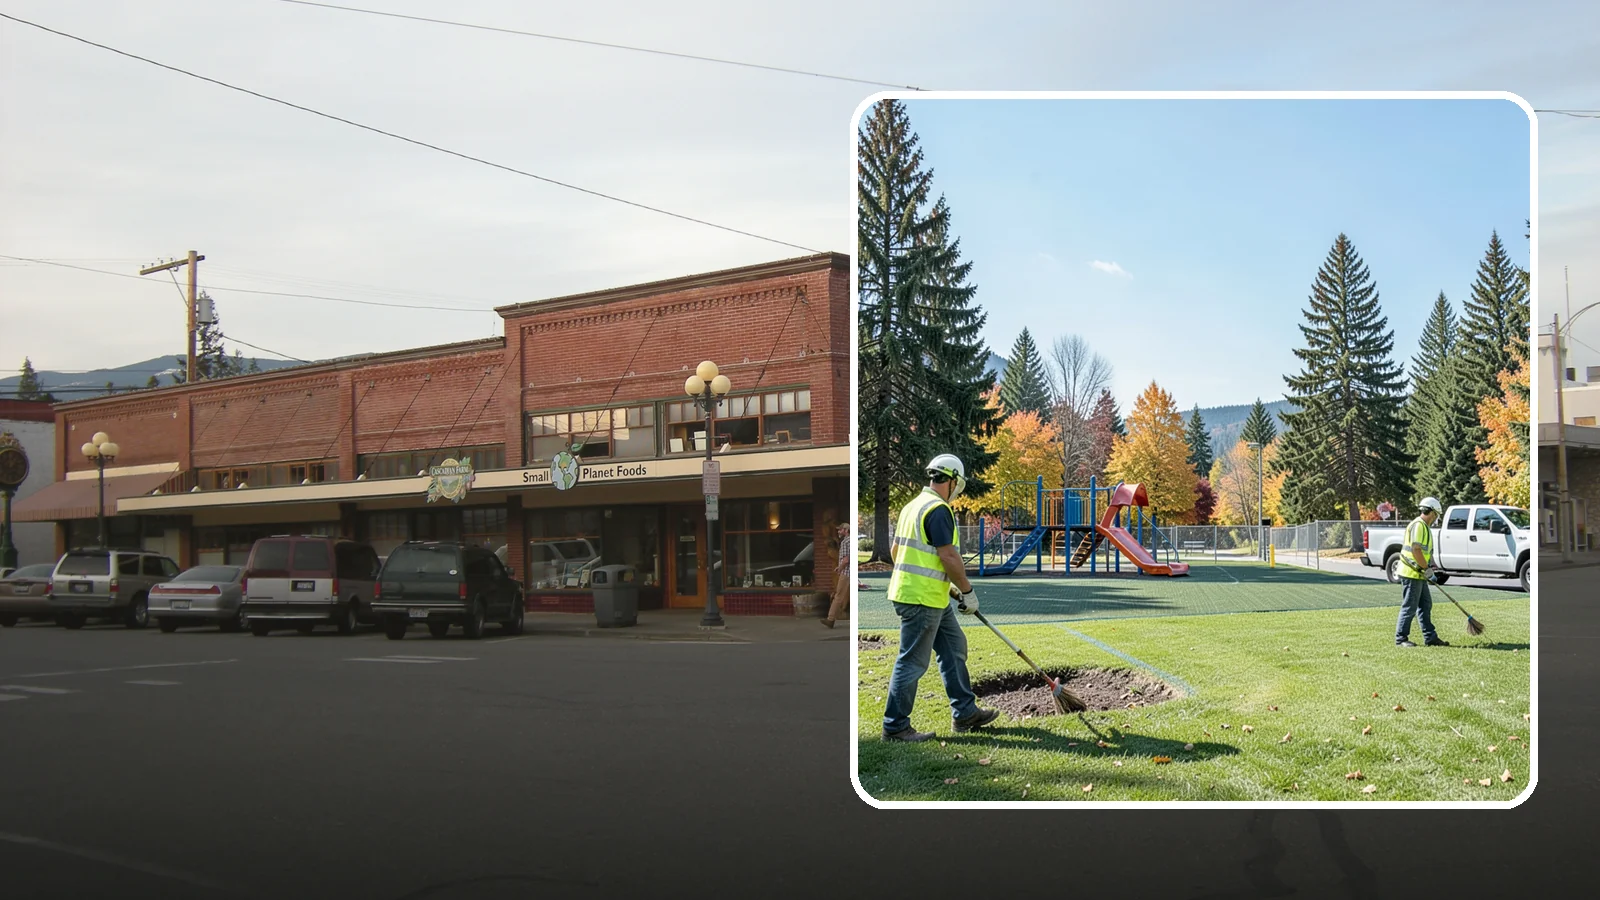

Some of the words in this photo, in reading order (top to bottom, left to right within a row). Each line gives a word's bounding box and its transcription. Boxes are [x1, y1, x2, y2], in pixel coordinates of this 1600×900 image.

[522, 470, 549, 483] Small
[582, 467, 614, 479] Planet
[616, 464, 647, 476] Foods
